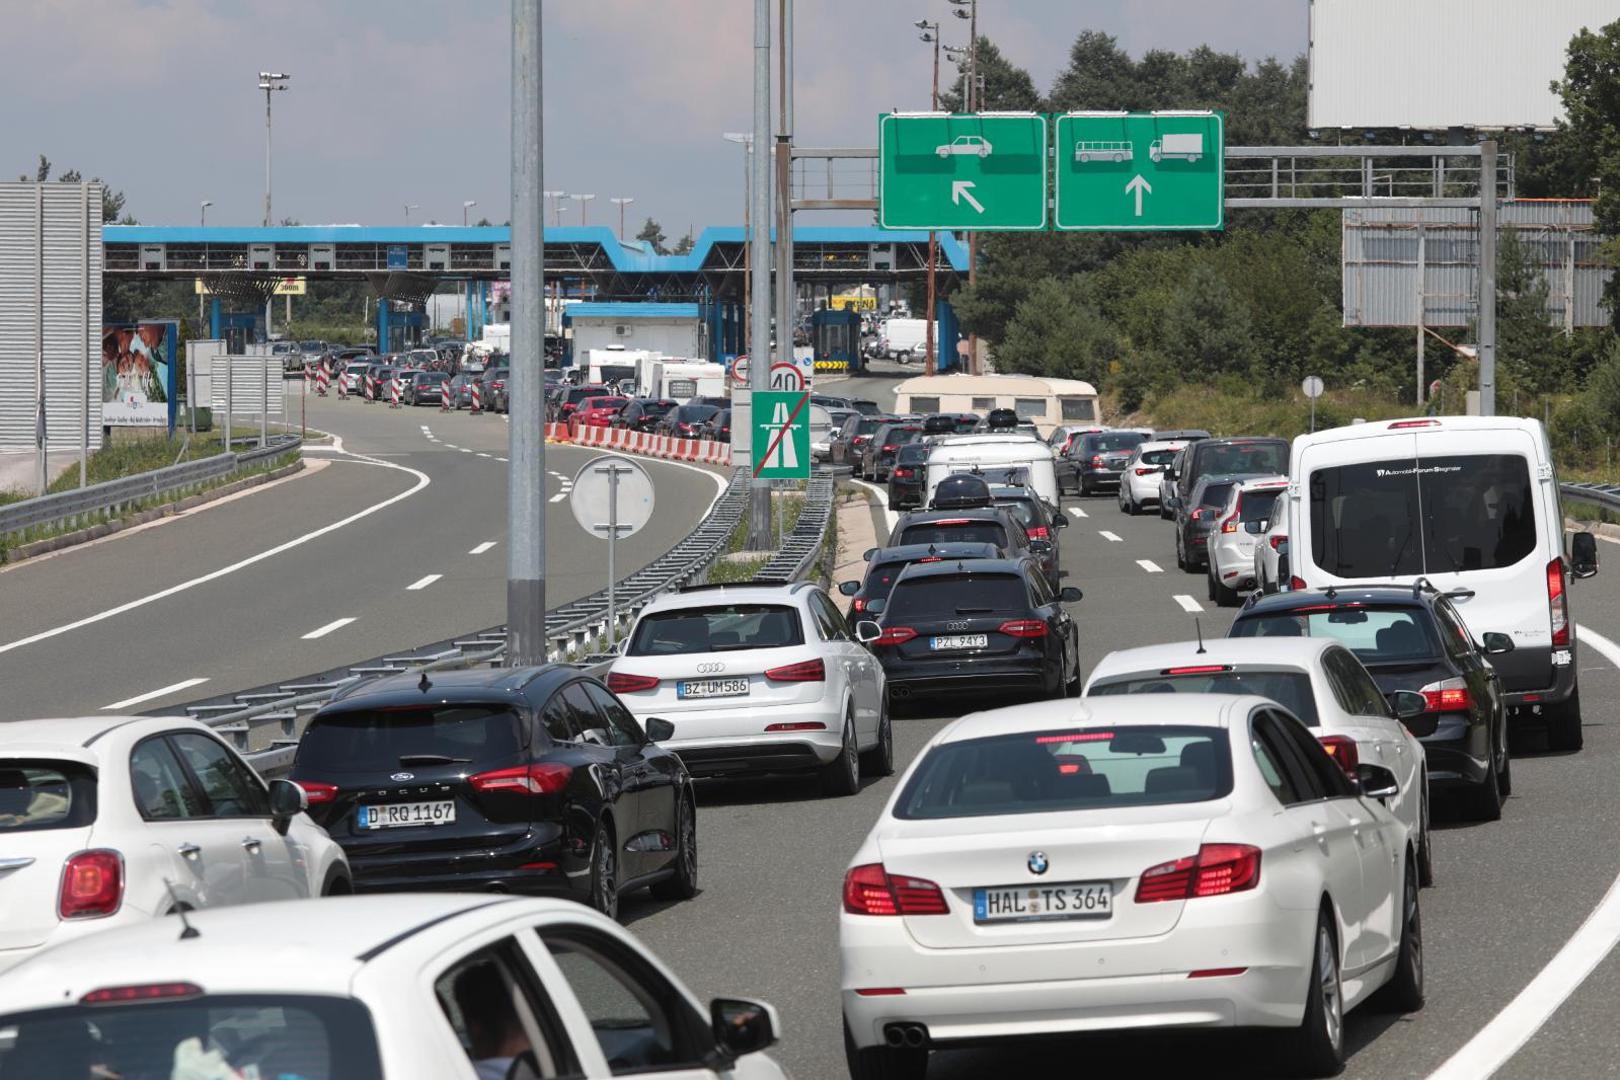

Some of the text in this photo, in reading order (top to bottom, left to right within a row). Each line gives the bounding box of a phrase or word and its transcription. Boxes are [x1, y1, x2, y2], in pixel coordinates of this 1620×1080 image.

[772, 373, 796, 391] 40
[937, 635, 985, 647] PZL 94Y3
[684, 682, 700, 695] BZ
[368, 803, 453, 823] D RQ 1167
[988, 887, 1109, 914] HAL TS 364
